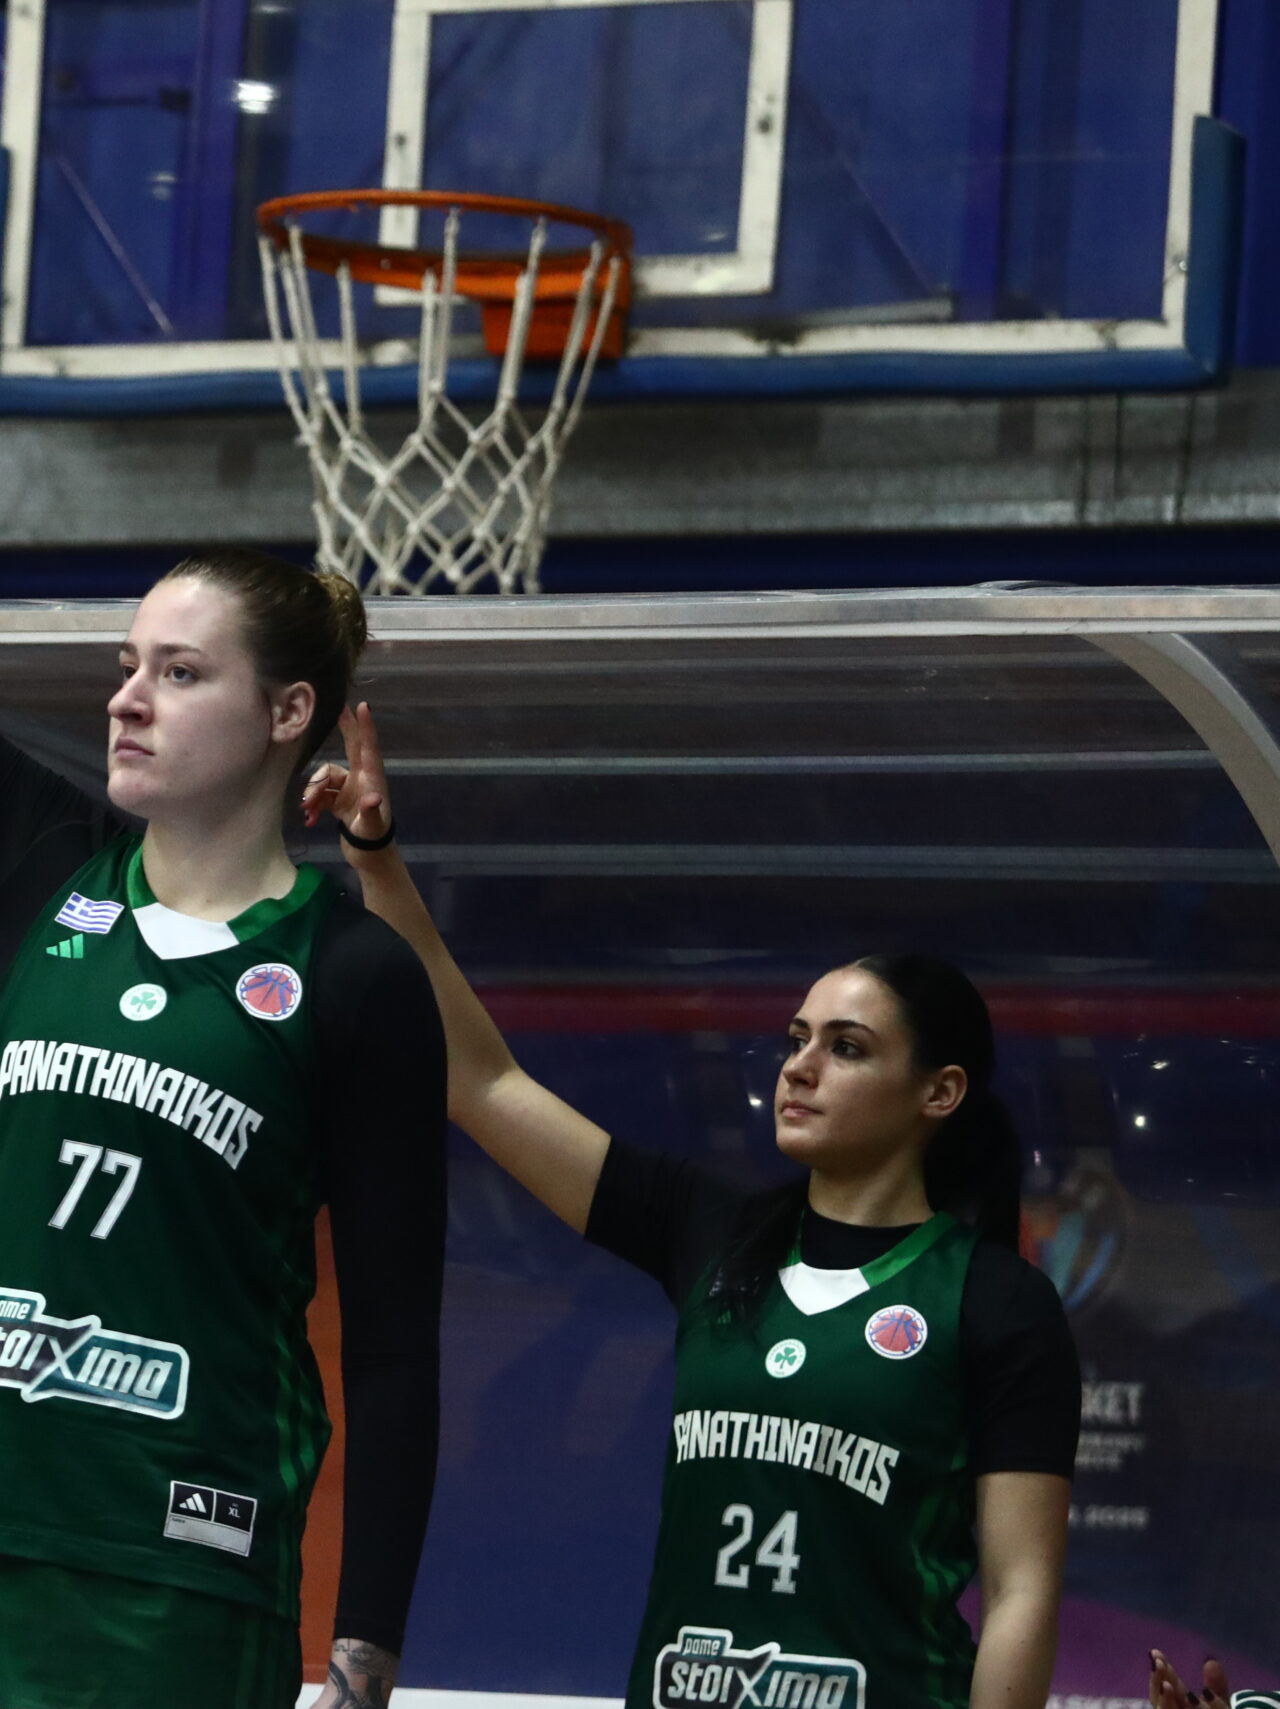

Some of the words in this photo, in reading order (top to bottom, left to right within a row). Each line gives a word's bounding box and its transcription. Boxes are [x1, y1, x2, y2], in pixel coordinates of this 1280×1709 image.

[47, 1138, 143, 1240] 77
[673, 1409, 900, 1506] PANATHINAIKOS
[713, 1503, 801, 1595] 24
[682, 1636, 721, 1656] pame
